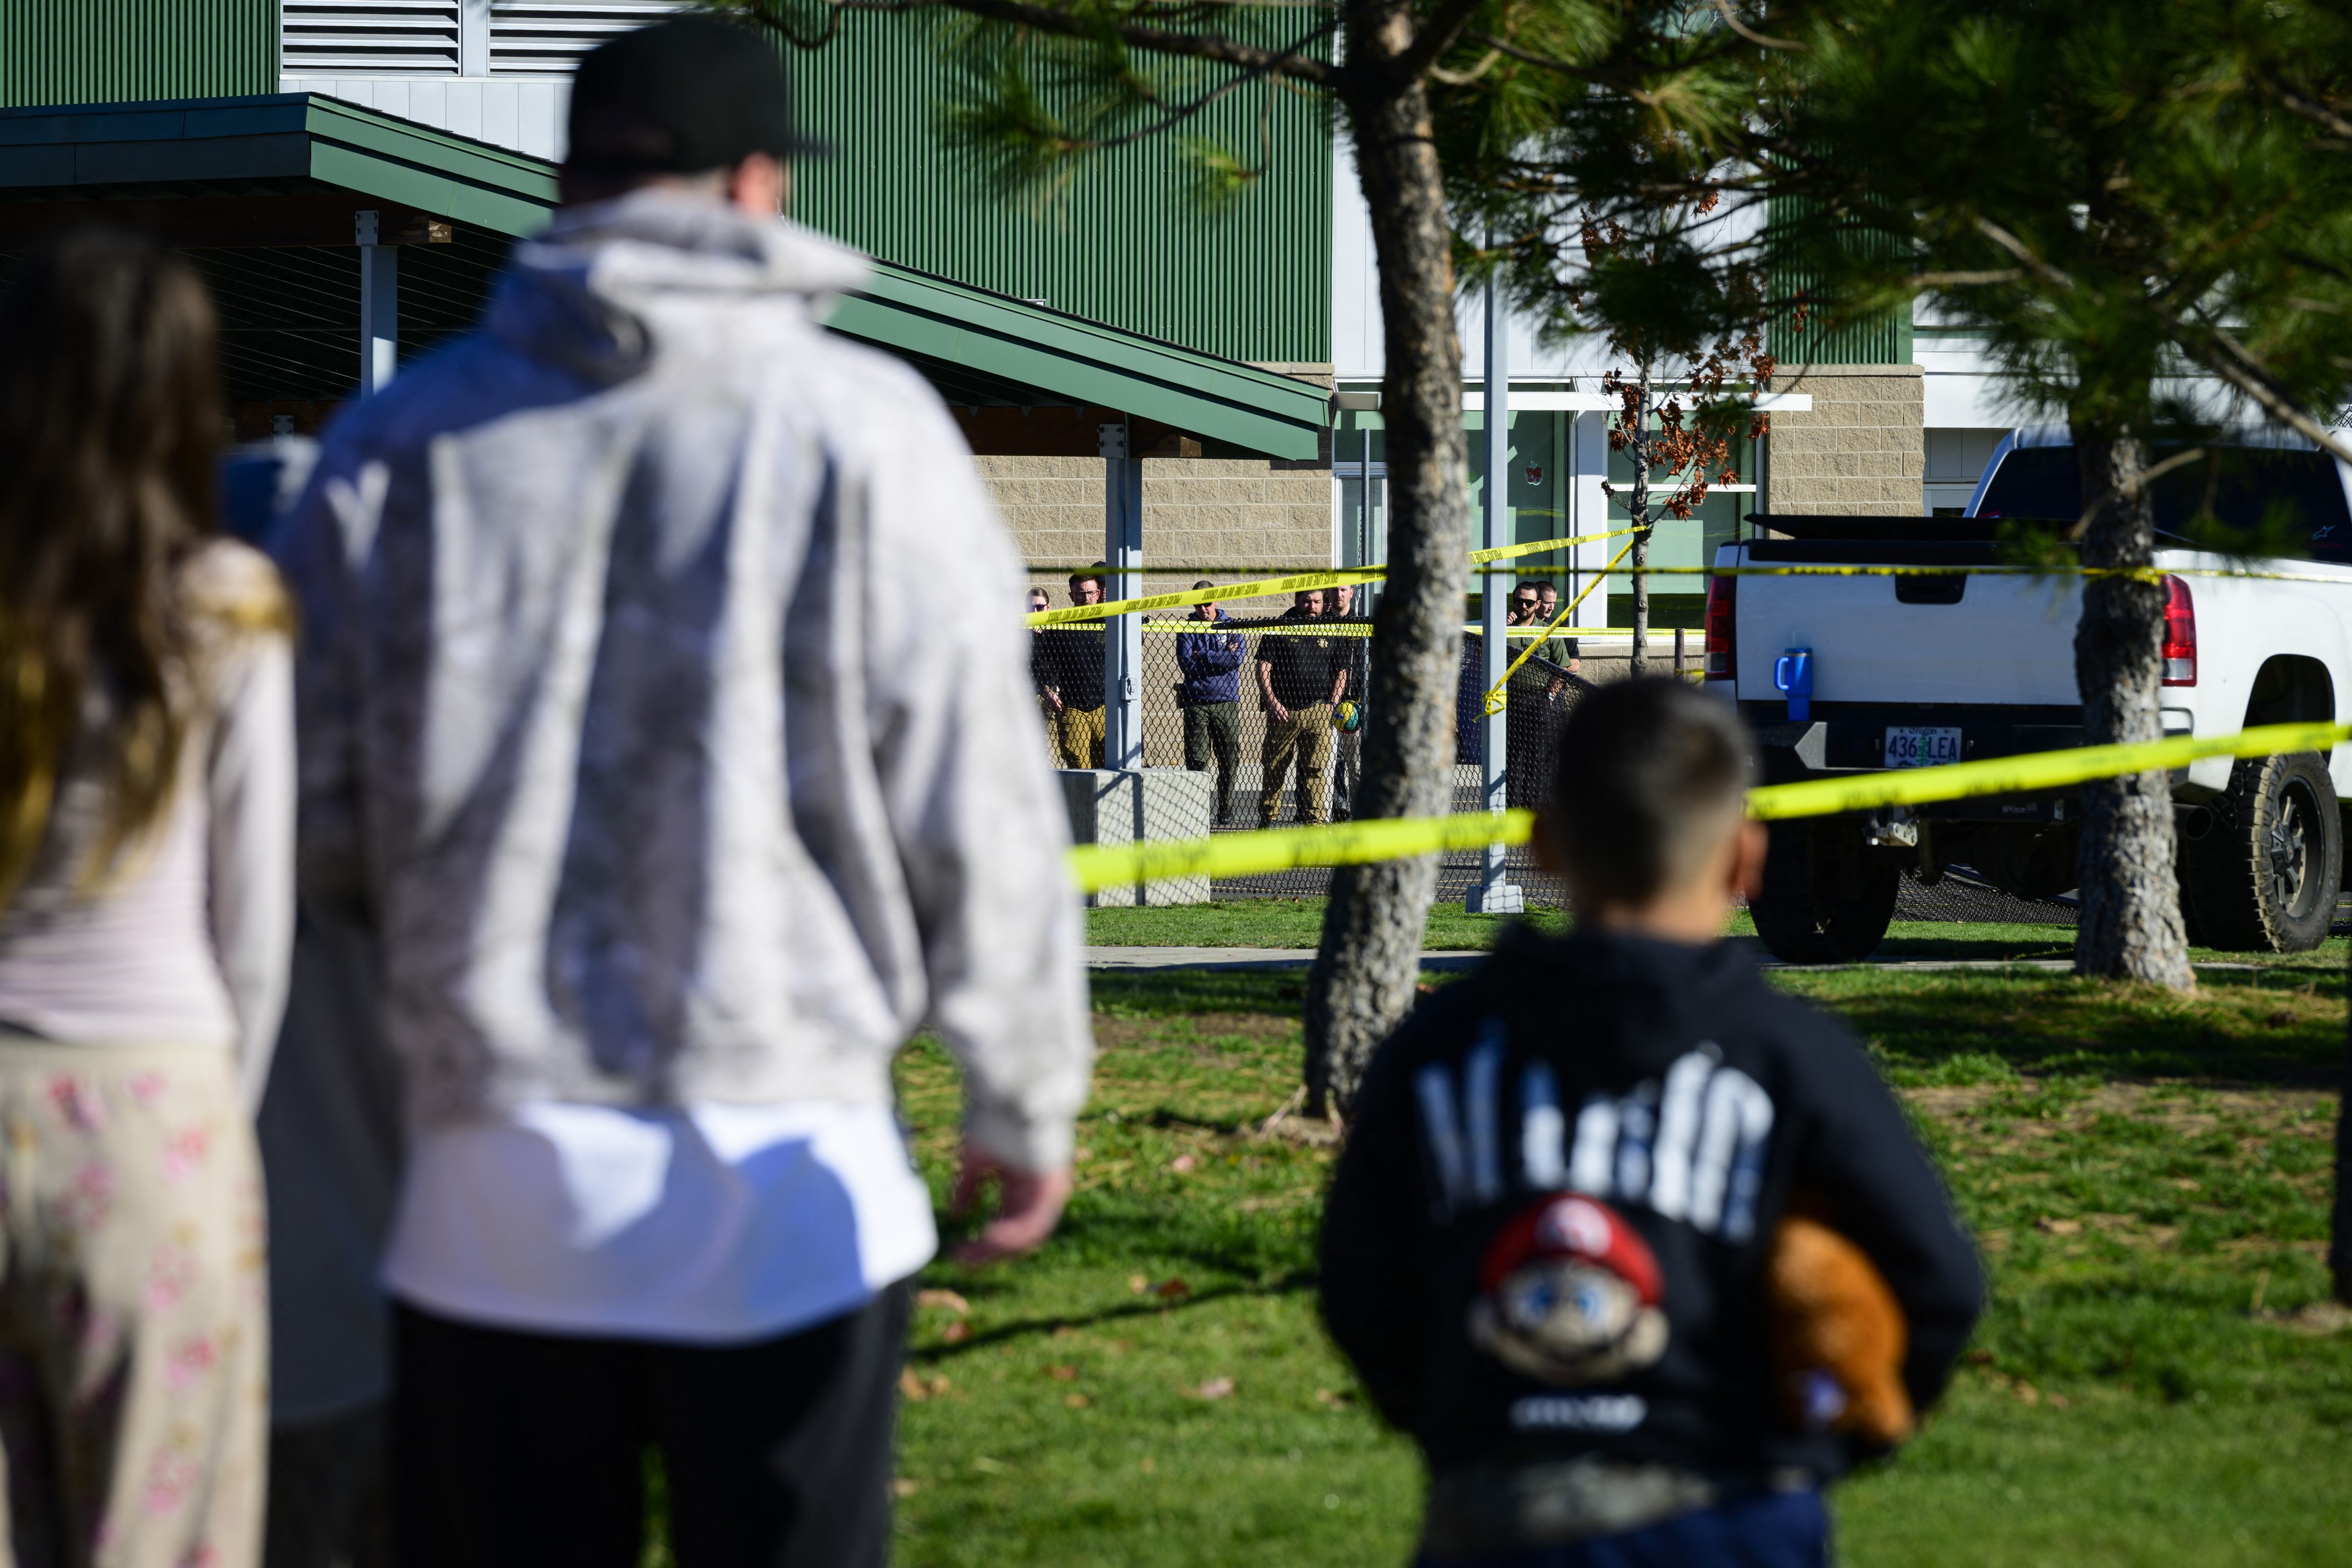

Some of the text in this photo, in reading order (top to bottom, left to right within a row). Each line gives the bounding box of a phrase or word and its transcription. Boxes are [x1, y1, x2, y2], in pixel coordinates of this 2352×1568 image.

[1541, 541, 1552, 551] NOT
[1571, 536, 1586, 545] POLICE
[1525, 543, 1541, 554] CROSS
[1474, 552, 1487, 563] LINE
[1486, 549, 1503, 562] POLICE
[1281, 572, 1339, 590] POLICE LINE DO NOT CROSS
[1202, 583, 1260, 601] POLICE LINE DO NOT CROSS
[1123, 594, 1182, 612] POLICE LINE DO NOT CROSS
[1046, 606, 1104, 623] POLICE LINE DO NOT CROSS
[1909, 728, 1937, 736] Oregon
[1888, 736, 1957, 759] 436 LEA
